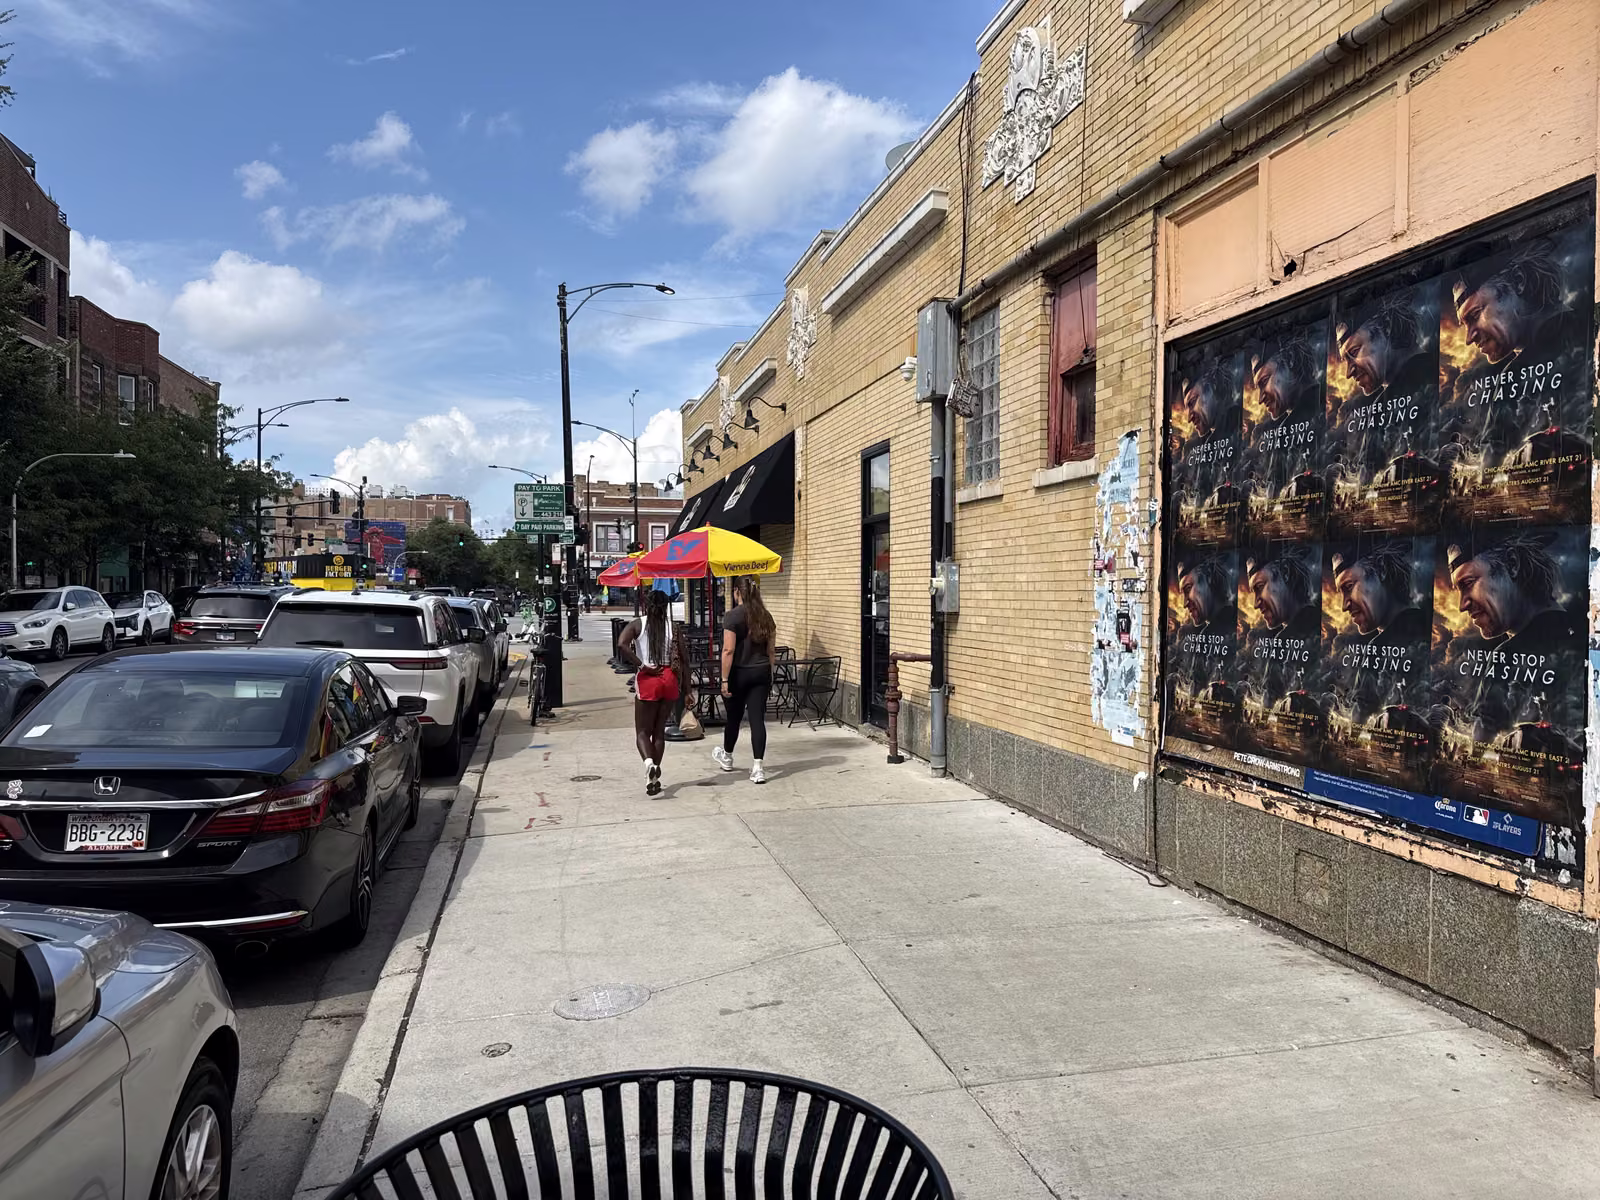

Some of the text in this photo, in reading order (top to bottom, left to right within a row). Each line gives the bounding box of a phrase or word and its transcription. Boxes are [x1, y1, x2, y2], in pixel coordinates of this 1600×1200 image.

[1474, 362, 1554, 390] NEVER STOP
[1467, 374, 1562, 408] CHASING
[1352, 396, 1412, 417] NEVER STOP
[1347, 406, 1418, 432] CHASING
[1264, 421, 1310, 440] NEVER STOP
[1192, 438, 1230, 454] NEVER STOP
[1258, 431, 1314, 452] CHASING
[1188, 446, 1234, 466] CHASING
[1540, 458, 1556, 466] RIVER
[1558, 455, 1572, 464] EAST
[752, 560, 768, 571] Beef
[1187, 634, 1224, 644] NEVER STOP
[1259, 638, 1304, 648] NEVER STOP
[1183, 643, 1228, 656] CHASING
[1254, 648, 1309, 662] CHASING
[1349, 644, 1405, 658] NEVER STOP
[1467, 649, 1545, 667] NEVER STOP
[1342, 654, 1412, 672] CHASING
[1459, 661, 1555, 685] CHASING
[1234, 752, 1247, 762] PETE
[1474, 740, 1500, 750] CHICAGO
[1530, 751, 1546, 759] RIVER
[1549, 754, 1563, 763] EAST
[1512, 764, 1532, 773] AUGUST
[1434, 800, 1456, 813] Corona
[69, 823, 144, 842] BBG-2236
[1496, 823, 1521, 836] PLAYERS
